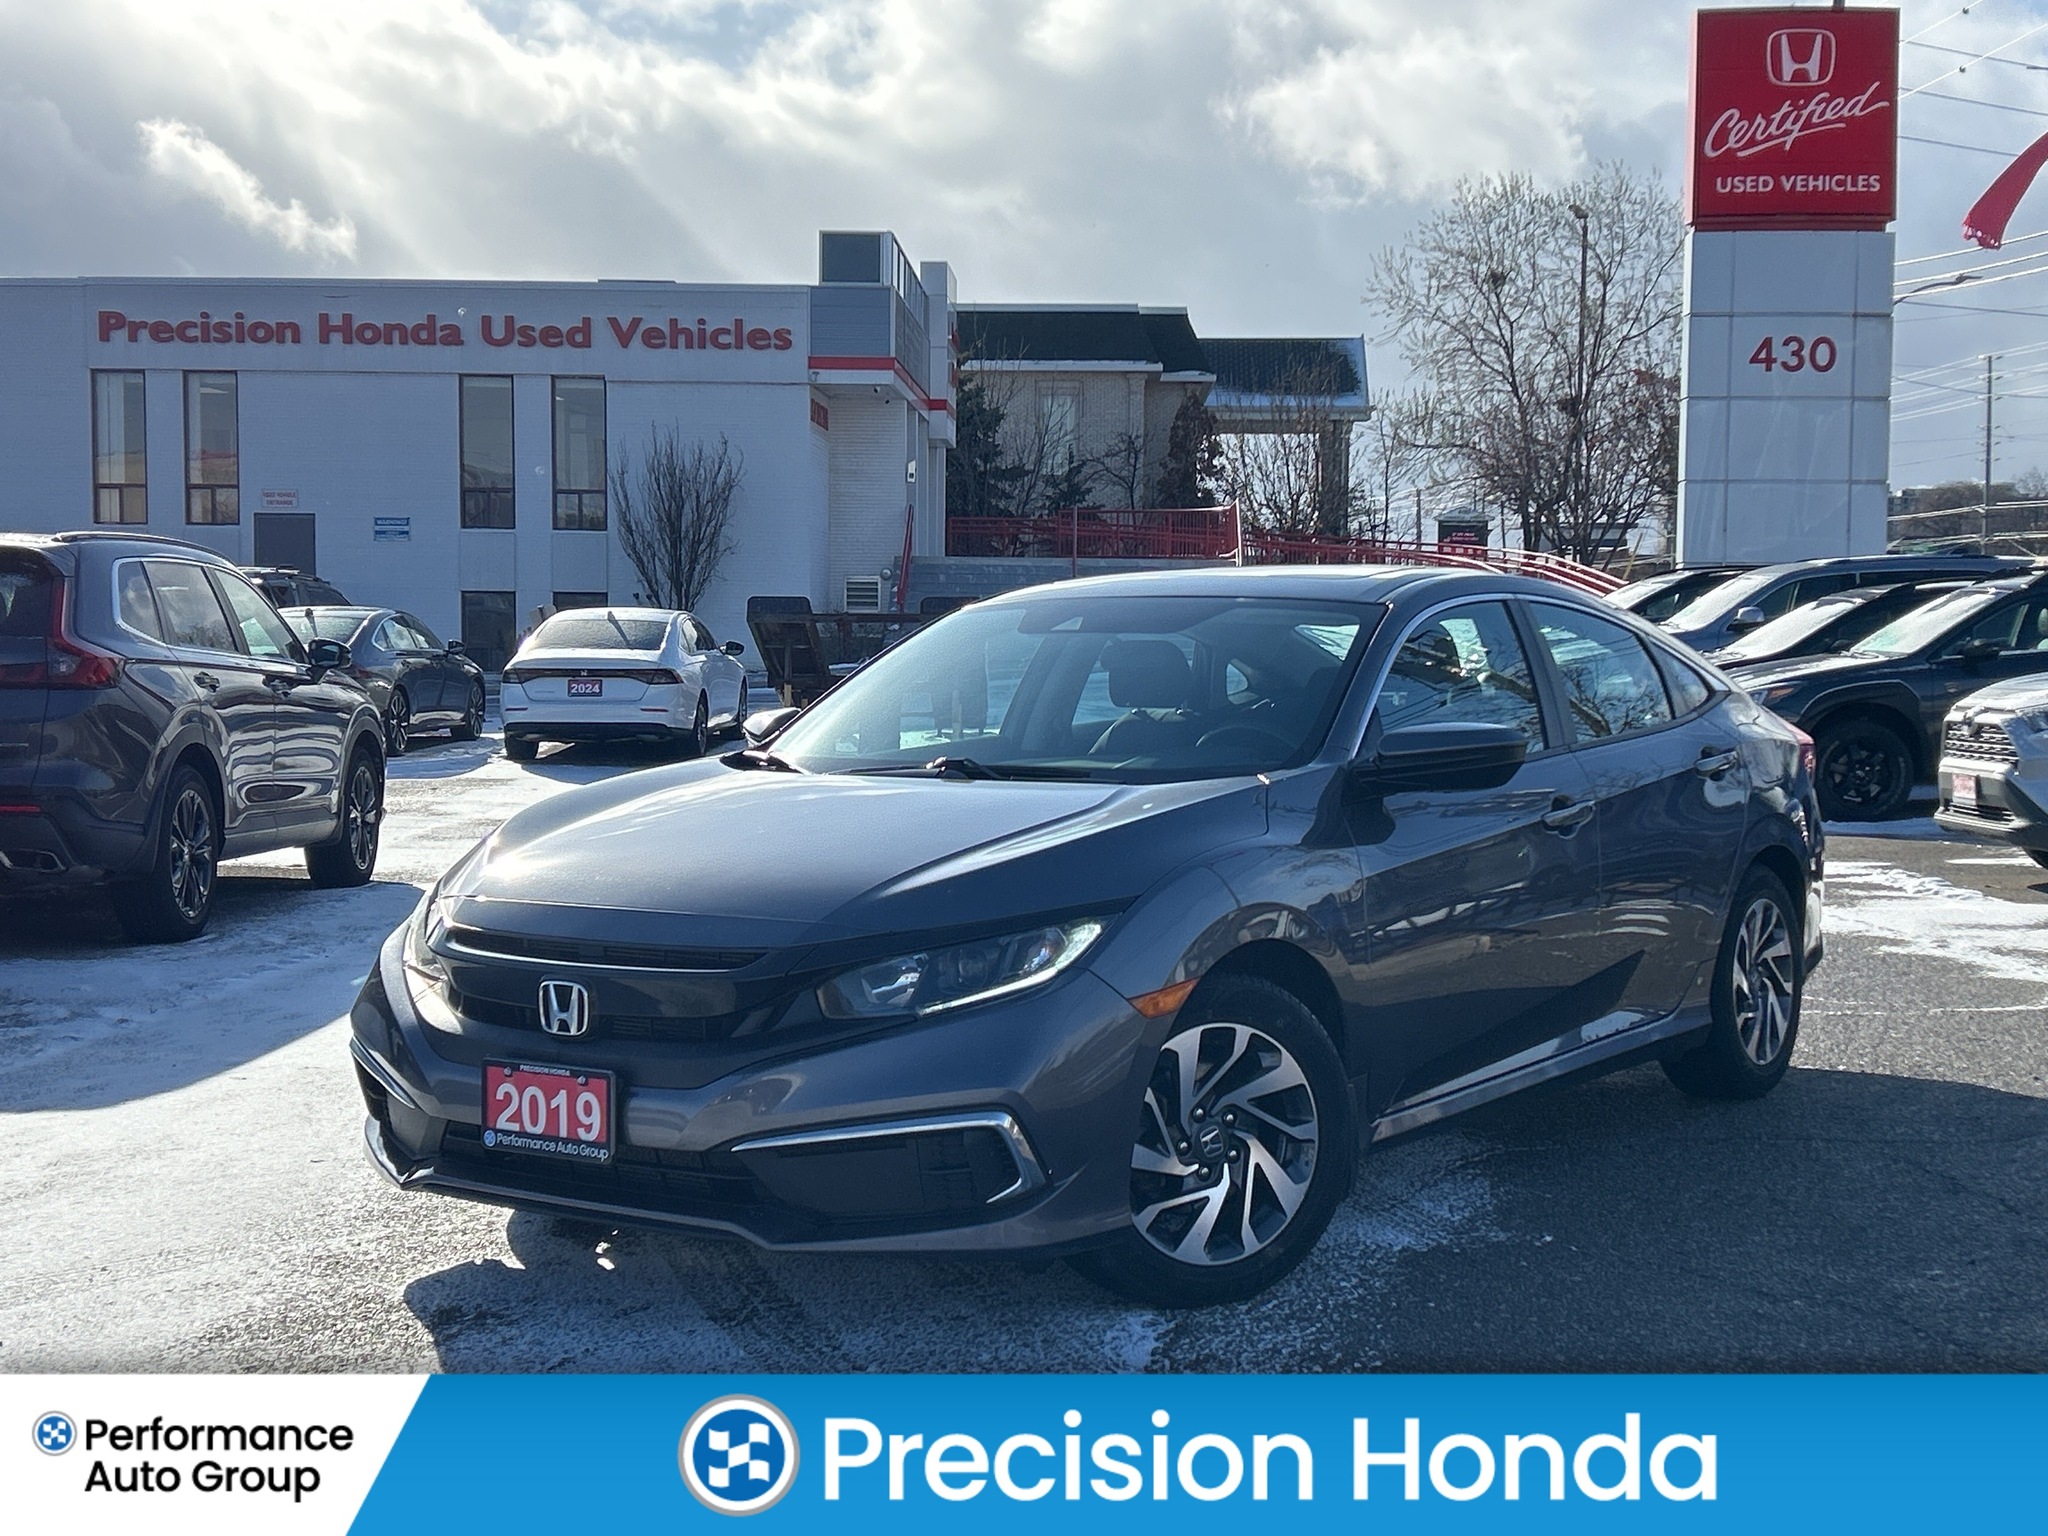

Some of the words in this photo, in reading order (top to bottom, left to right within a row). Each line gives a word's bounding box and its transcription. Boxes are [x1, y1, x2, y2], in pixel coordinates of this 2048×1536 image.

[1704, 81, 1890, 158] Certified
[1716, 175, 1775, 193] USED
[1780, 174, 1881, 192] VEHICLES
[97, 310, 301, 344] Precision
[318, 312, 464, 346] Honda
[480, 315, 592, 348] Used
[606, 316, 793, 350] Vehicles
[1749, 335, 1837, 373] 430
[570, 683, 600, 694] 2024
[495, 1082, 601, 1142] 2019
[496, 1132, 557, 1153] Performance
[557, 1141, 579, 1155] Auto
[579, 1145, 609, 1163] Group
